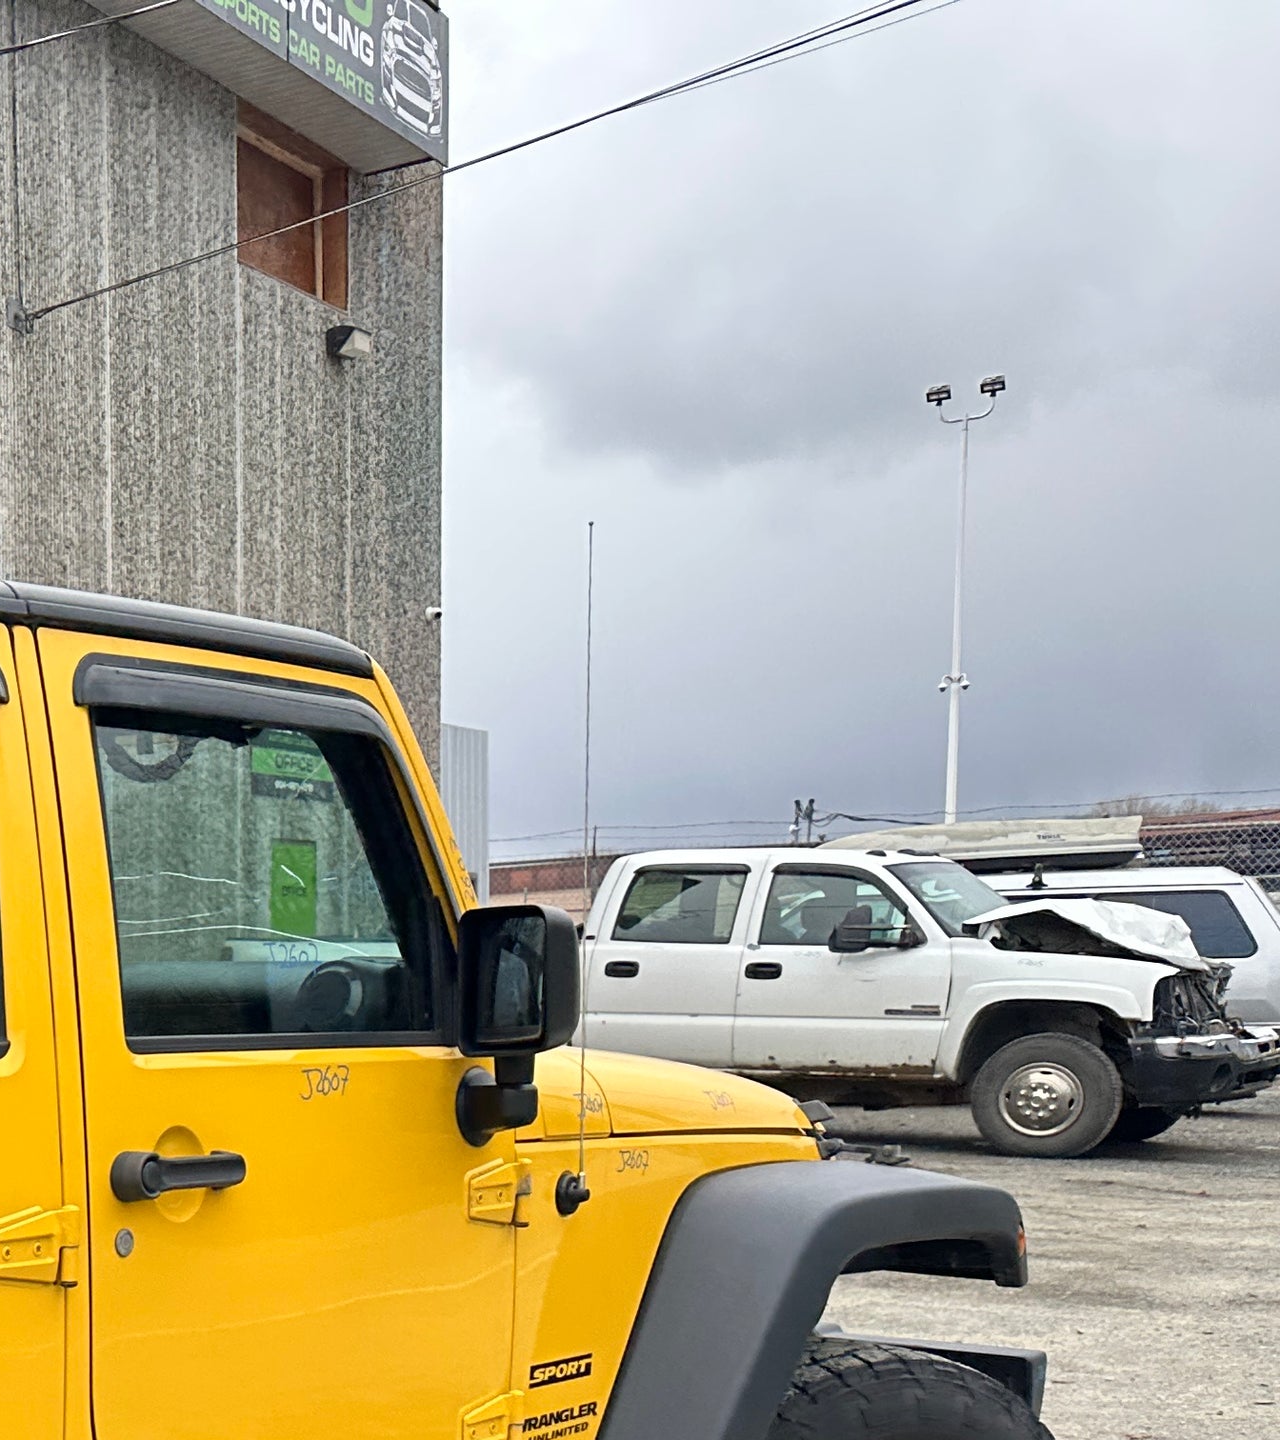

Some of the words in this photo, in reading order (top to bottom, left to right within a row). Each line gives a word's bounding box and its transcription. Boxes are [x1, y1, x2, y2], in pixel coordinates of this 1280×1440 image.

[274, 0, 374, 67] YCLING
[289, 29, 321, 71] CAR
[325, 54, 375, 105] PARTS
[300, 1065, 350, 1101] J2607
[616, 1150, 650, 1176] J2607
[530, 1359, 591, 1384] SPORT
